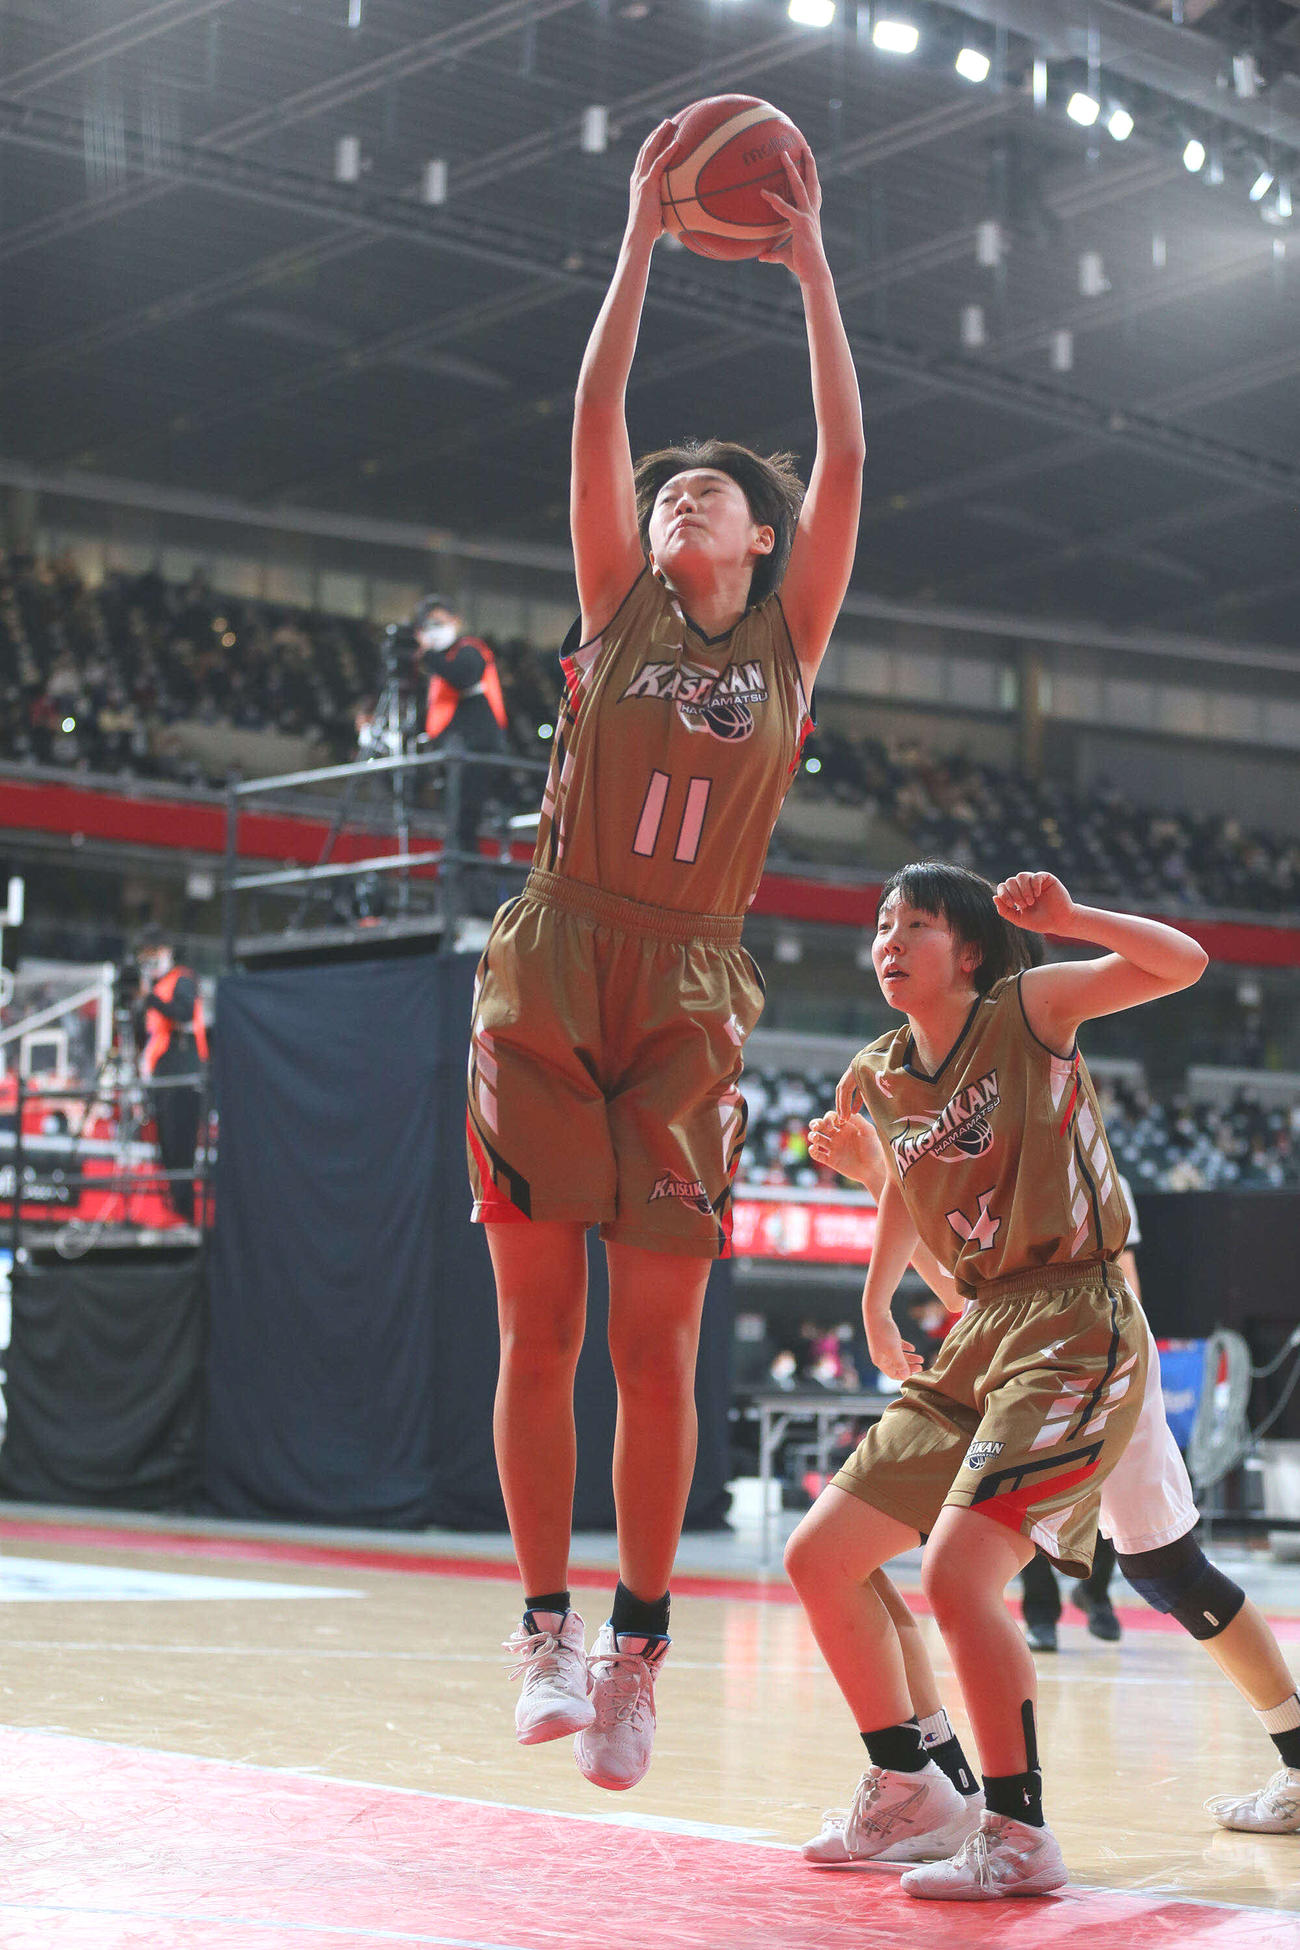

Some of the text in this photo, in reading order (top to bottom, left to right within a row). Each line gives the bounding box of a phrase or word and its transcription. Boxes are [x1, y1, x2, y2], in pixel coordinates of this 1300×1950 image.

[632, 768, 712, 864] 11
[933, 1096, 1001, 1156] HAMAMATSU
[945, 1184, 1001, 1250] 4
